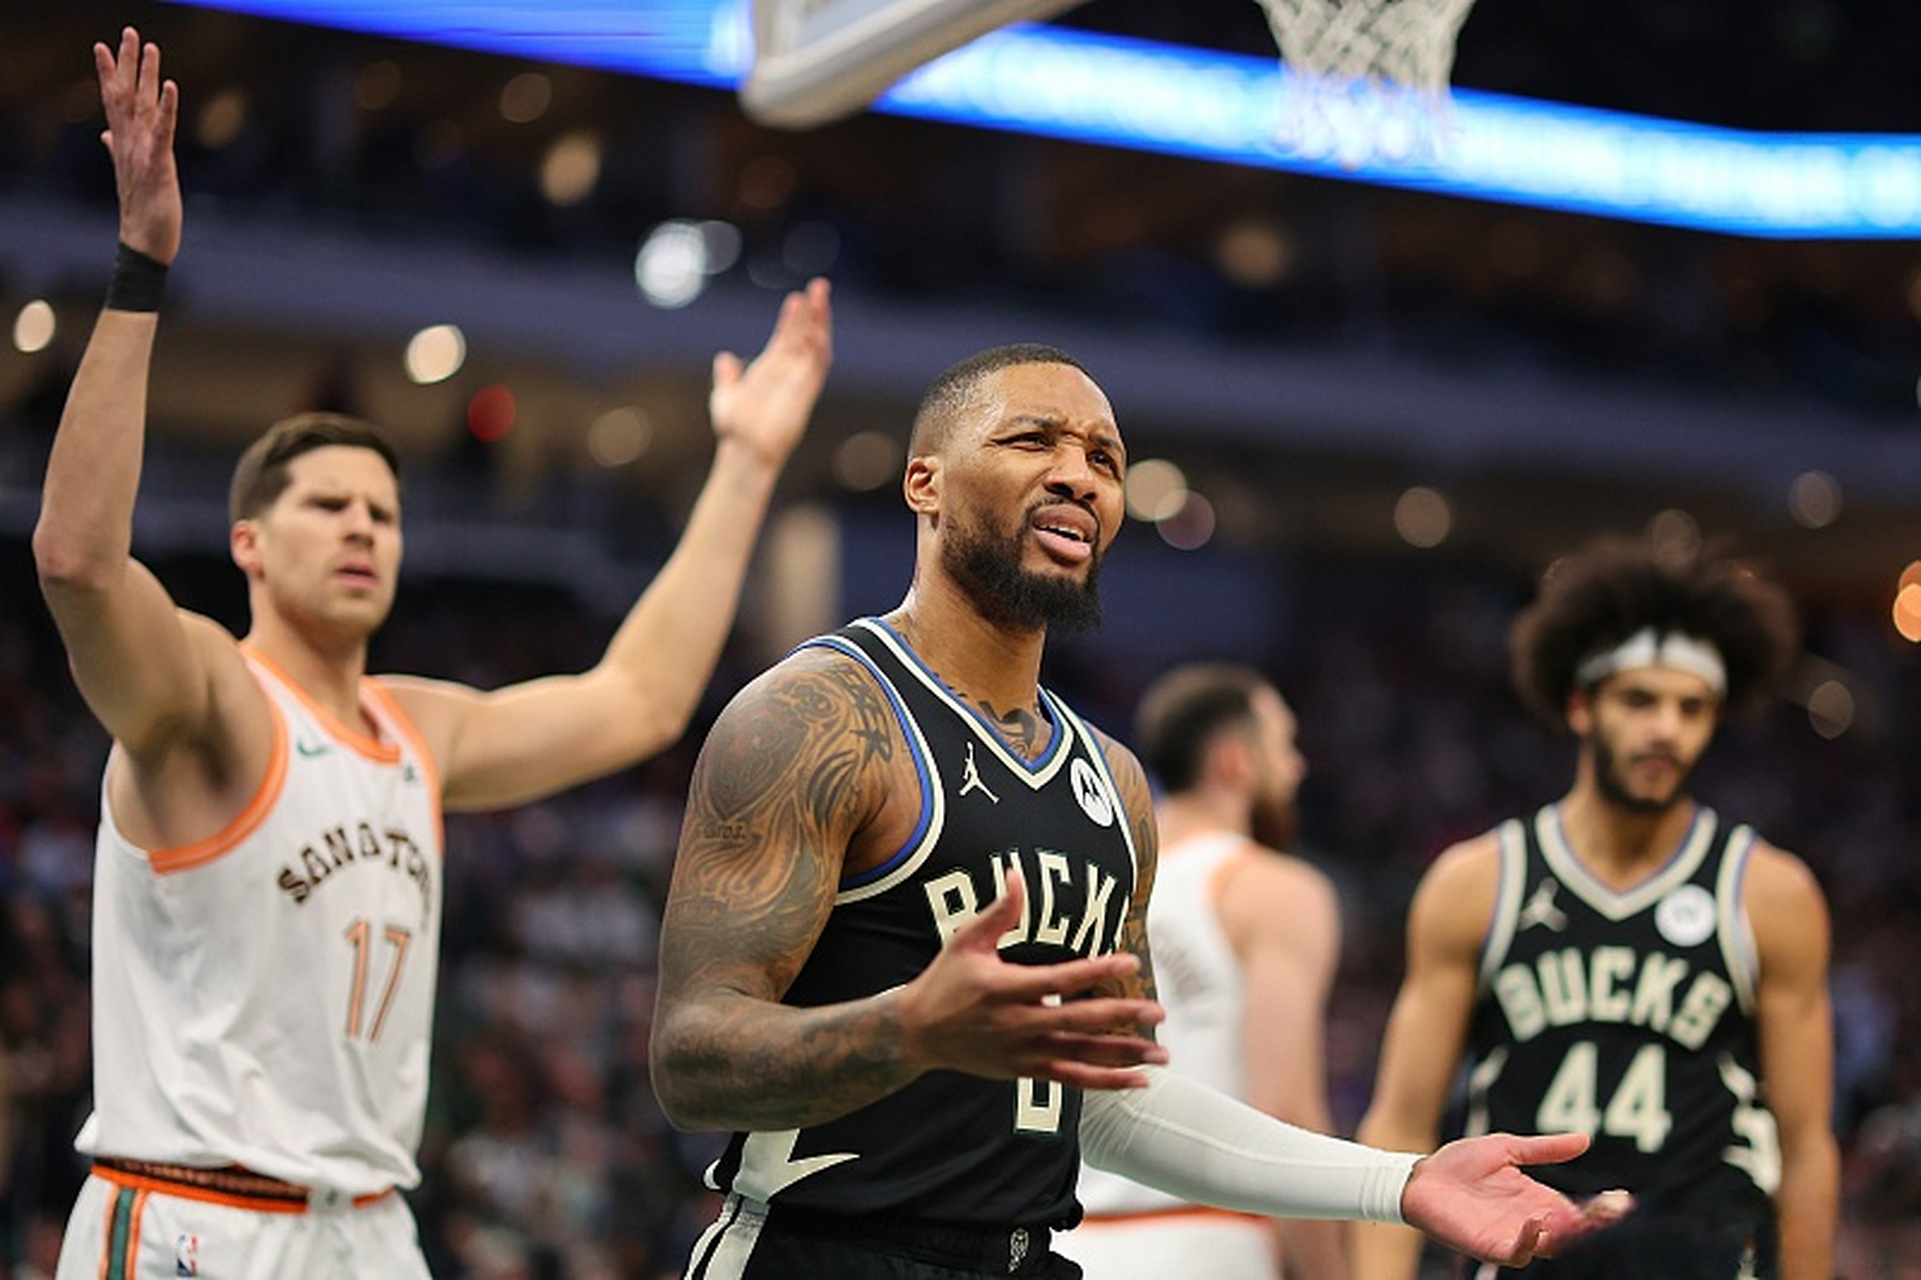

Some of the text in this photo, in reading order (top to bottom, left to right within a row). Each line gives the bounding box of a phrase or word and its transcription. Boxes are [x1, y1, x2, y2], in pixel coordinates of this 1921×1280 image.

[345, 919, 412, 1041] 17
[1494, 945, 1733, 1051] BUCKS
[1535, 1041, 1673, 1153] 44
